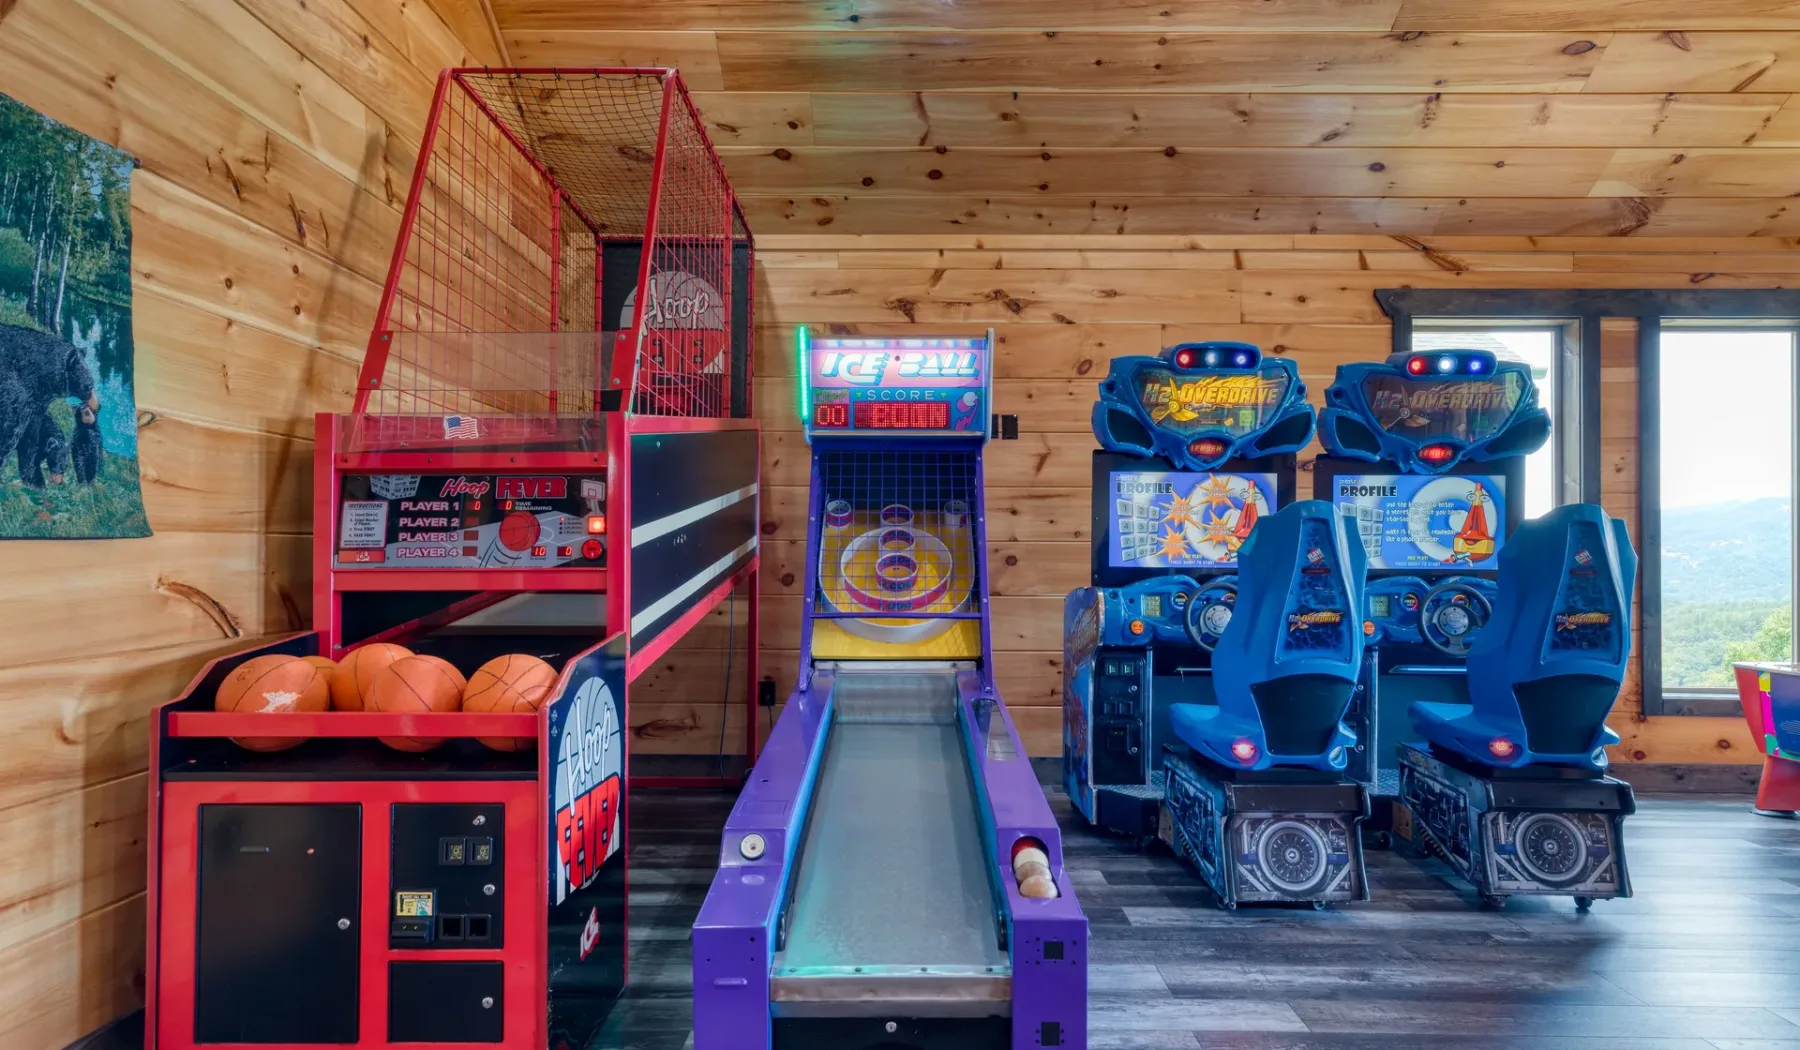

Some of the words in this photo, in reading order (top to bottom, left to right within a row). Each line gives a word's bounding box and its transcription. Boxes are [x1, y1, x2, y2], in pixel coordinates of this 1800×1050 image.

[820, 352, 890, 386] ICE
[898, 352, 980, 377] BALL
[867, 390, 935, 401] SCORE
[817, 405, 845, 425] 00
[440, 477, 490, 499] Hoop
[496, 477, 568, 499] FEVER
[1116, 482, 1173, 494] PROFILE
[1340, 485, 1398, 498] PROFILE
[400, 501, 449, 511] PLAYER
[452, 501, 459, 511] 1
[474, 501, 481, 511] 0
[505, 500, 513, 511] 0
[399, 517, 447, 527] PLAYER
[449, 517, 460, 527] 2
[398, 532, 447, 542] PLAYER
[449, 532, 459, 542] 3
[397, 548, 447, 558] PLAYER
[449, 548, 459, 558] 4
[533, 546, 546, 556] 10
[565, 546, 573, 556] 0
[566, 695, 612, 818] Hoop
[556, 775, 621, 907] FEVER
